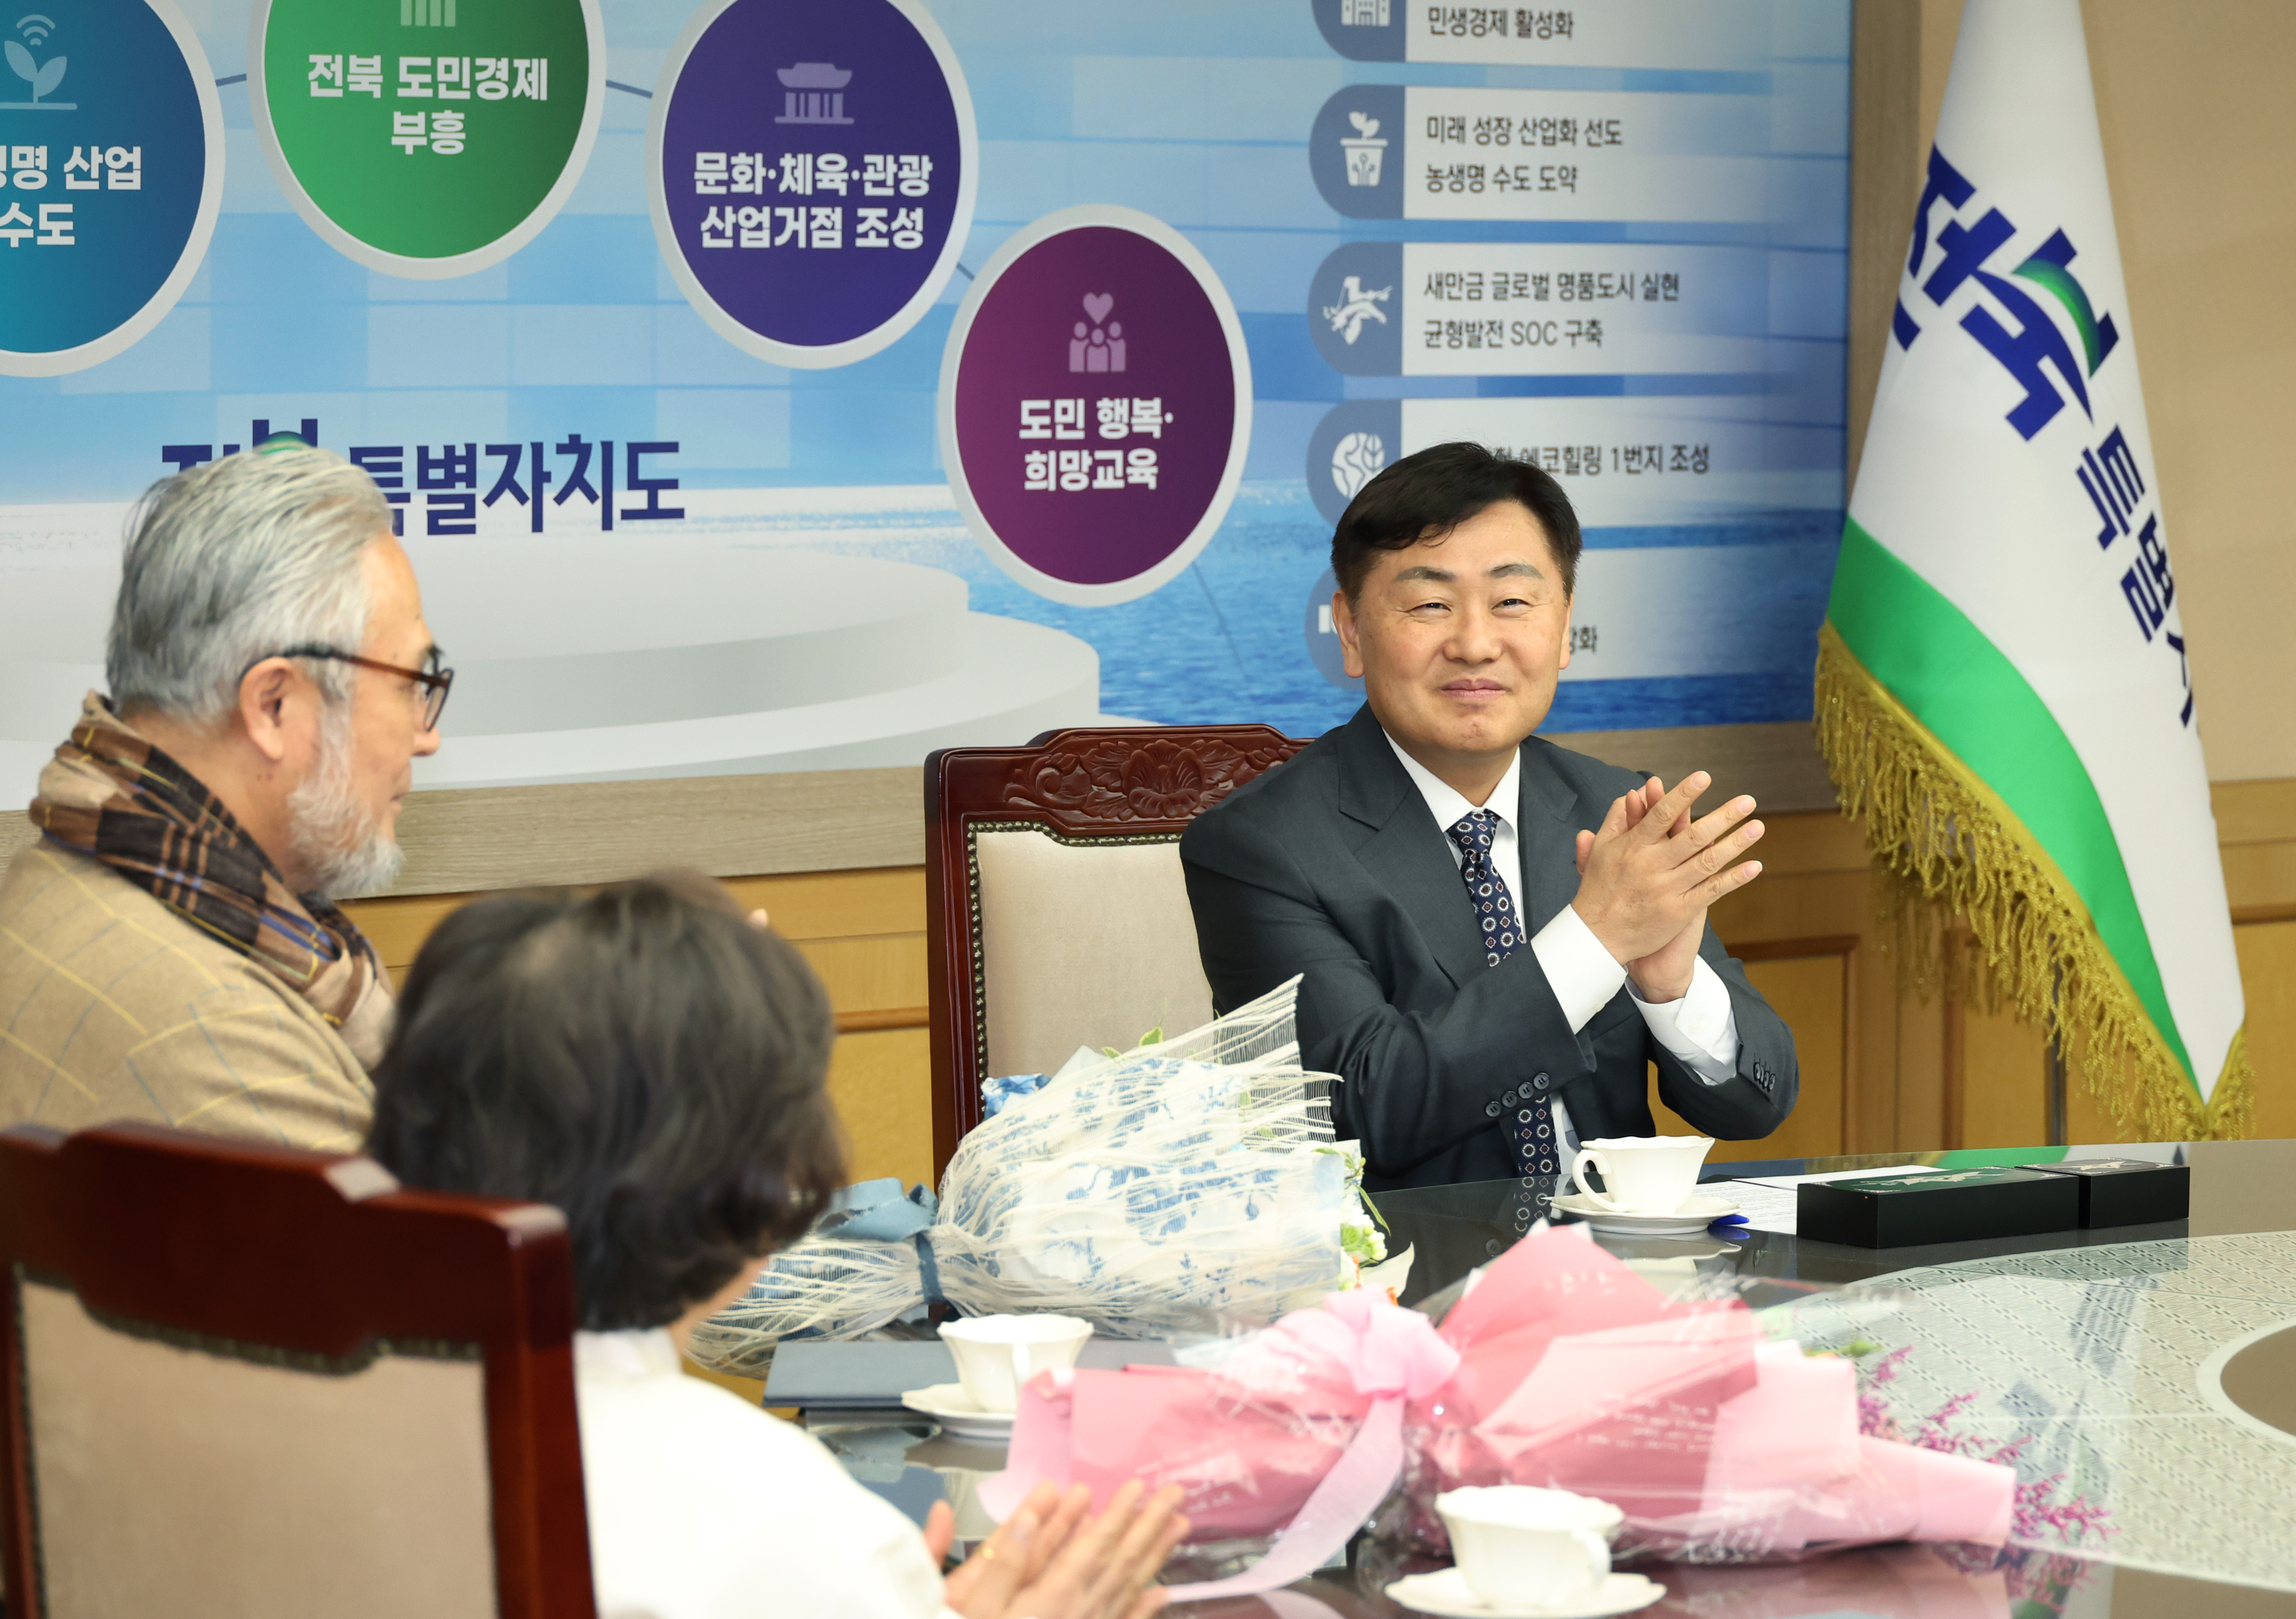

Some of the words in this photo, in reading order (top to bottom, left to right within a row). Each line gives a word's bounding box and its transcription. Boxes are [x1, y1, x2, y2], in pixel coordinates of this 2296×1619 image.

[1428, 6, 1508, 37] 민생경제
[1514, 8, 1574, 40] 활성화
[308, 54, 383, 98] 전북
[397, 57, 548, 101] 도민경제
[391, 110, 466, 155] 부흥
[1427, 115, 1466, 145] 미래
[1472, 117, 1513, 146] 성장
[1518, 118, 1578, 147] 산업화
[1584, 119, 1623, 148] 선도
[0, 145, 48, 190] 명
[64, 146, 141, 190] 산업
[1424, 163, 1485, 194] 농생명
[1492, 164, 1532, 193] 수도
[1538, 165, 1578, 193] 도약
[0, 202, 75, 248] 수도
[701, 206, 843, 248] 산업거점
[855, 207, 924, 249] 조성
[1423, 272, 1484, 301] 새만금
[1491, 272, 1550, 301] 글로벌
[1557, 272, 1635, 302] 명품도시
[1641, 273, 1680, 301] 실현
[1423, 320, 1504, 350] 균형발전
[1510, 320, 1558, 346] SOC
[1564, 319, 1603, 348] 구축
[1019, 398, 1085, 440] 도민
[1024, 448, 1158, 491] 희망교육
[1669, 444, 1709, 474] 조성
